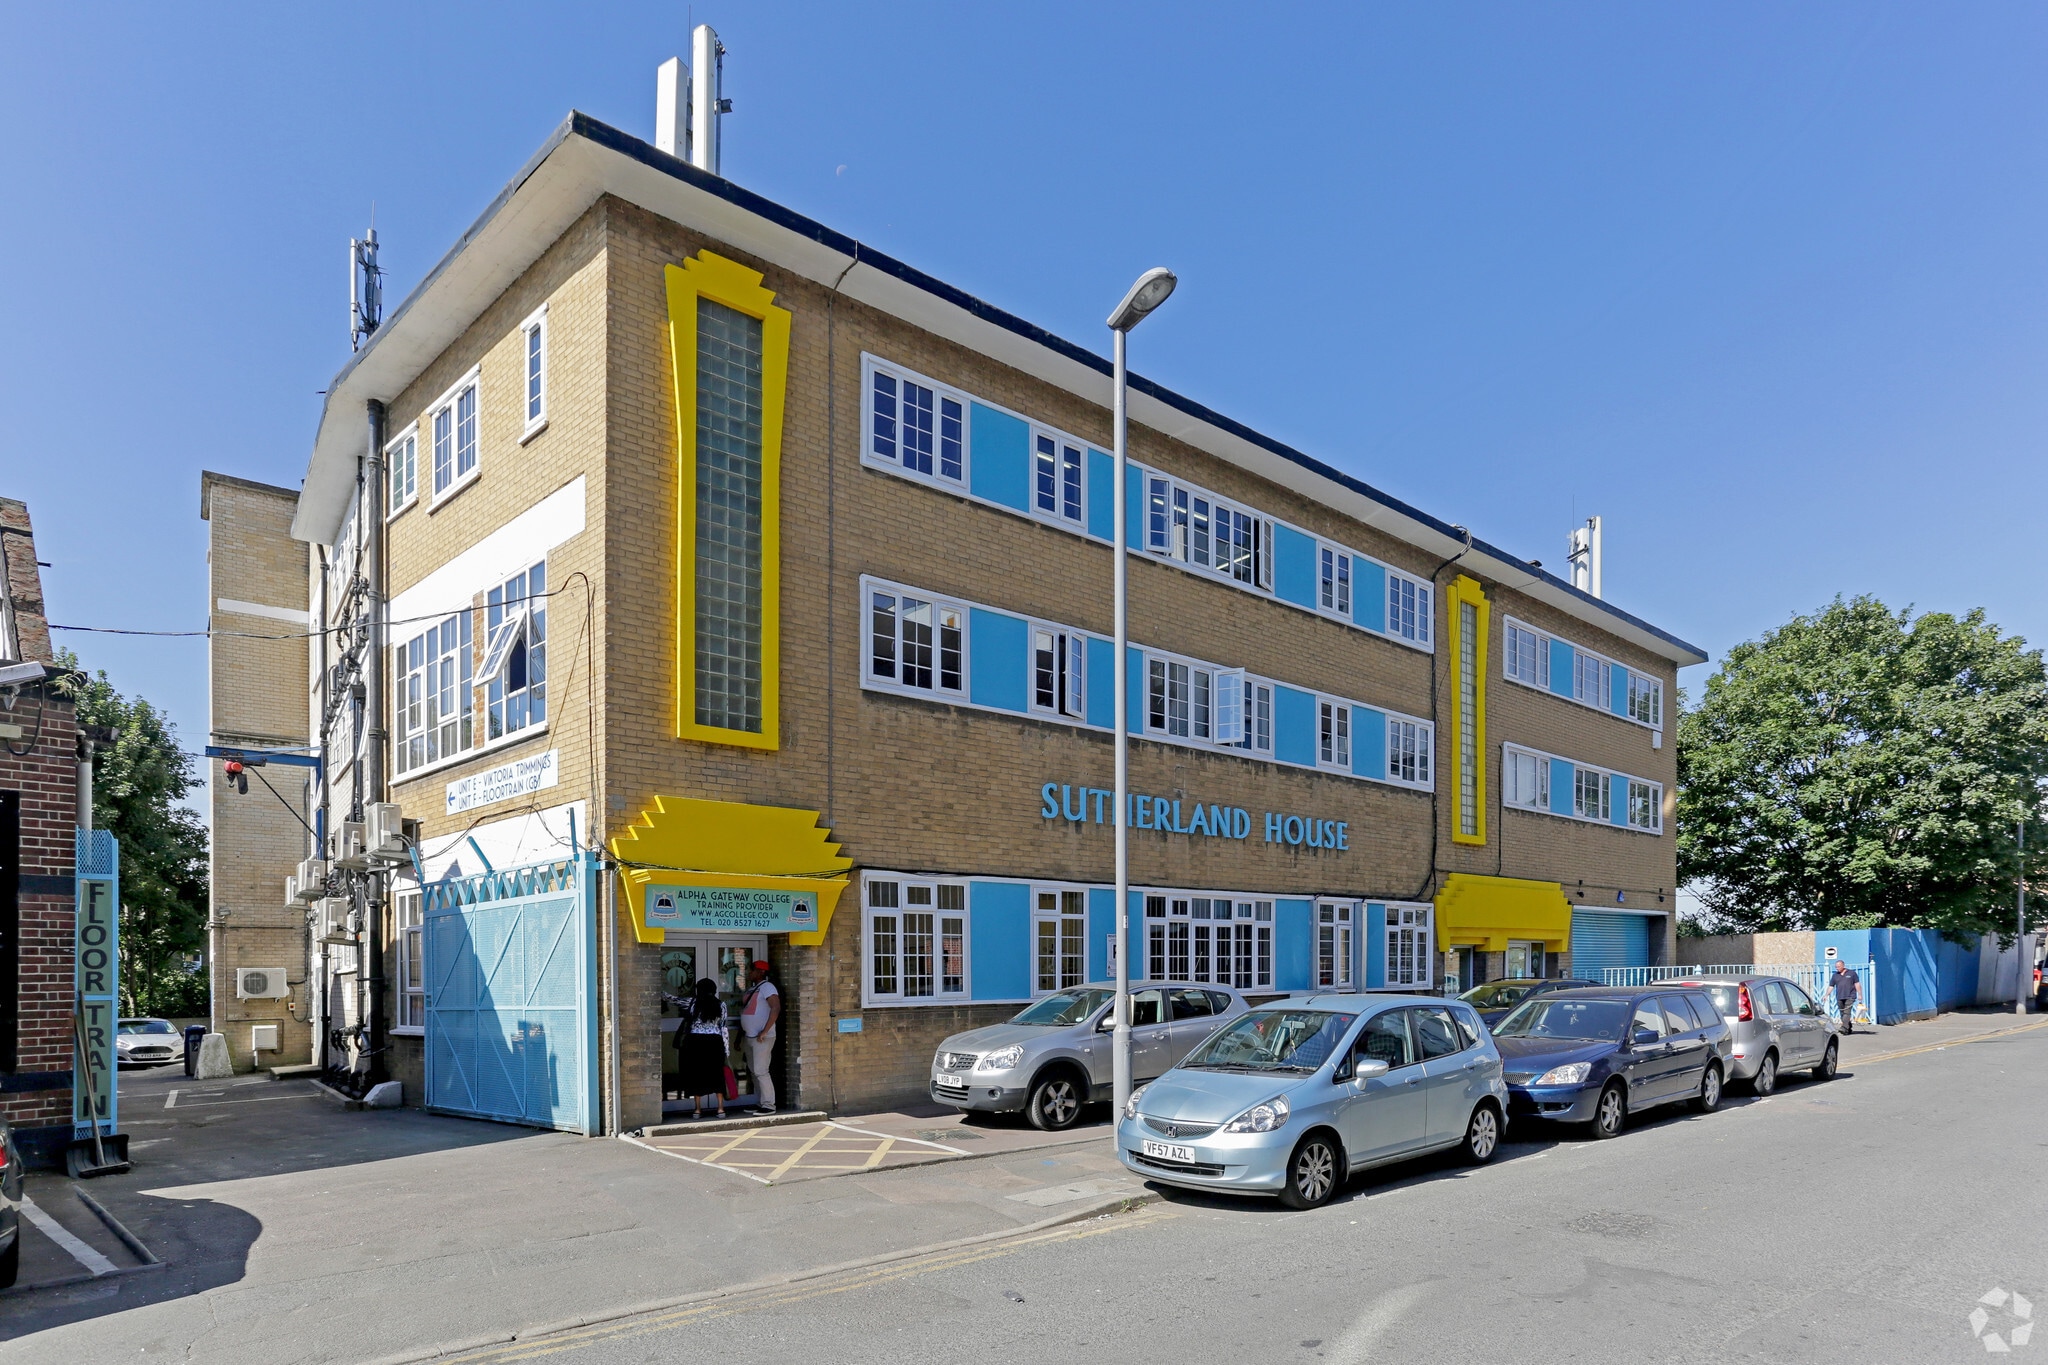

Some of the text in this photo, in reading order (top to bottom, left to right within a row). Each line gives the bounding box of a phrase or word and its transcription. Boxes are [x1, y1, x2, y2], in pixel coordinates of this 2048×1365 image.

[459, 779, 471, 794] UNIT
[483, 767, 513, 787] VIKTORIA
[516, 754, 551, 777] TRIMMINGS
[459, 793, 471, 809] UNIT
[483, 780, 523, 802] FLOORTRAIN
[1041, 782, 1349, 850] SUTHERLAND HOUSE
[677, 890, 790, 904] ALPHA GATEWAY COLLEGE
[697, 901, 774, 911] TRAINING PROVIDER
[690, 909, 779, 920] WWW.AGCOLLEGE.CO.UK
[700, 919, 715, 927] TEL:
[734, 919, 752, 927] 8527
[754, 920, 770, 928] 1627
[81, 883, 107, 1116] FLOOR TRAIN
[1147, 1142, 1190, 1160] VF57 AZL
